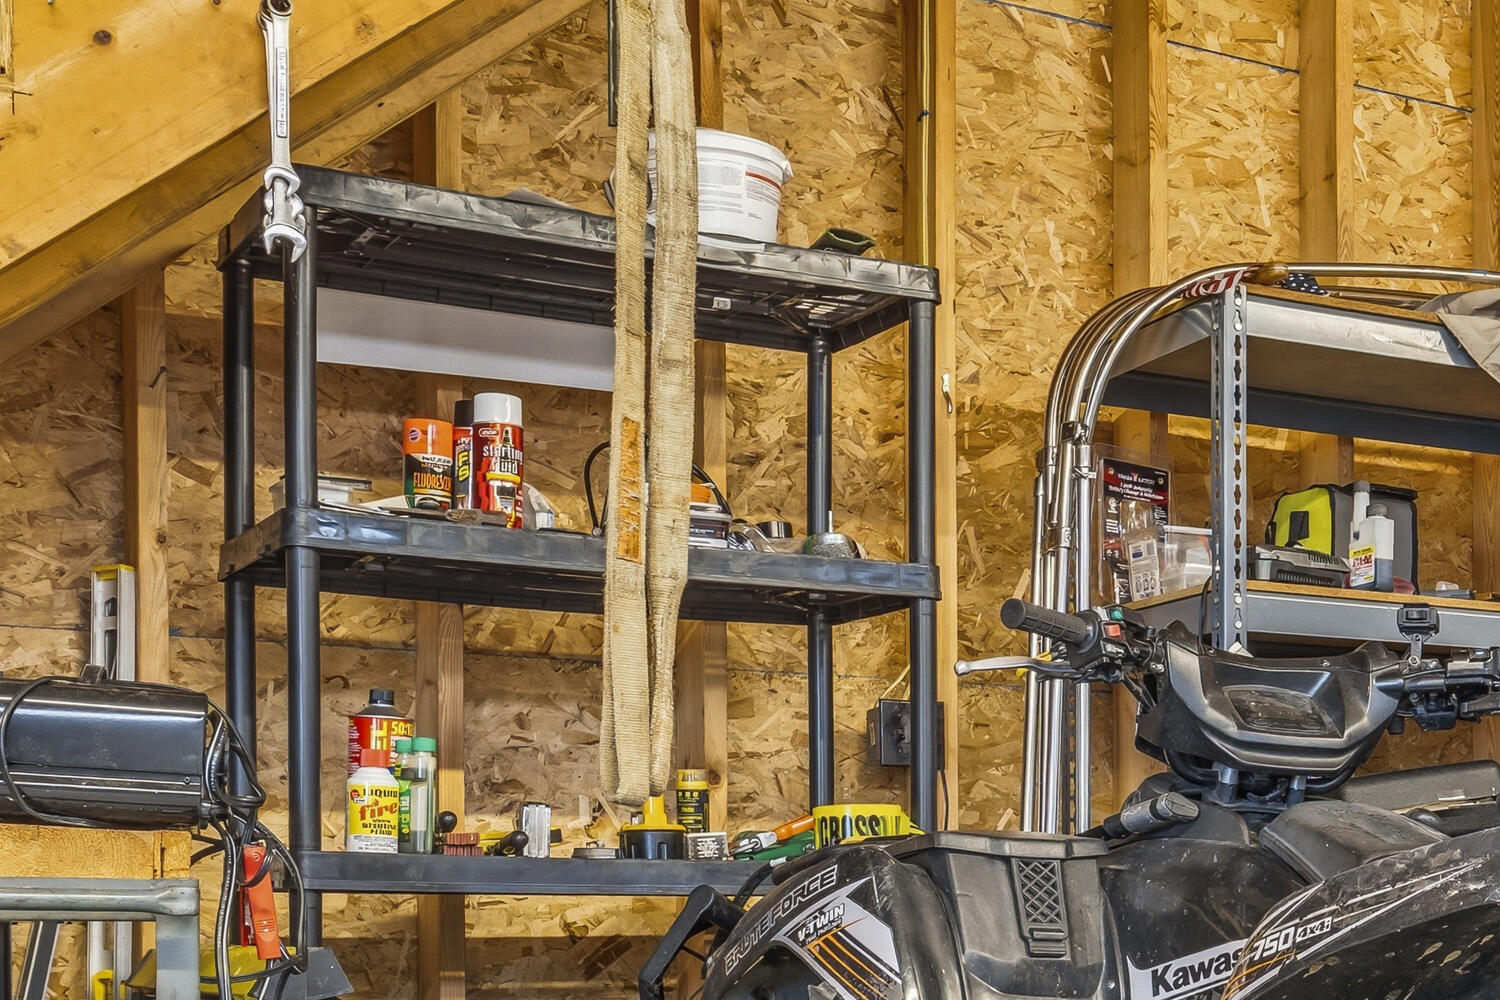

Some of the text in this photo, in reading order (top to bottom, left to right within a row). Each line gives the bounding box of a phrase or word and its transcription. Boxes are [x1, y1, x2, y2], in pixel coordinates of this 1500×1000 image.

[359, 799, 398, 821] fire
[363, 788, 398, 799] LIQUID
[770, 864, 839, 927] FORCE
[797, 903, 846, 942] V-TWIN
[1253, 926, 1296, 962] 750
